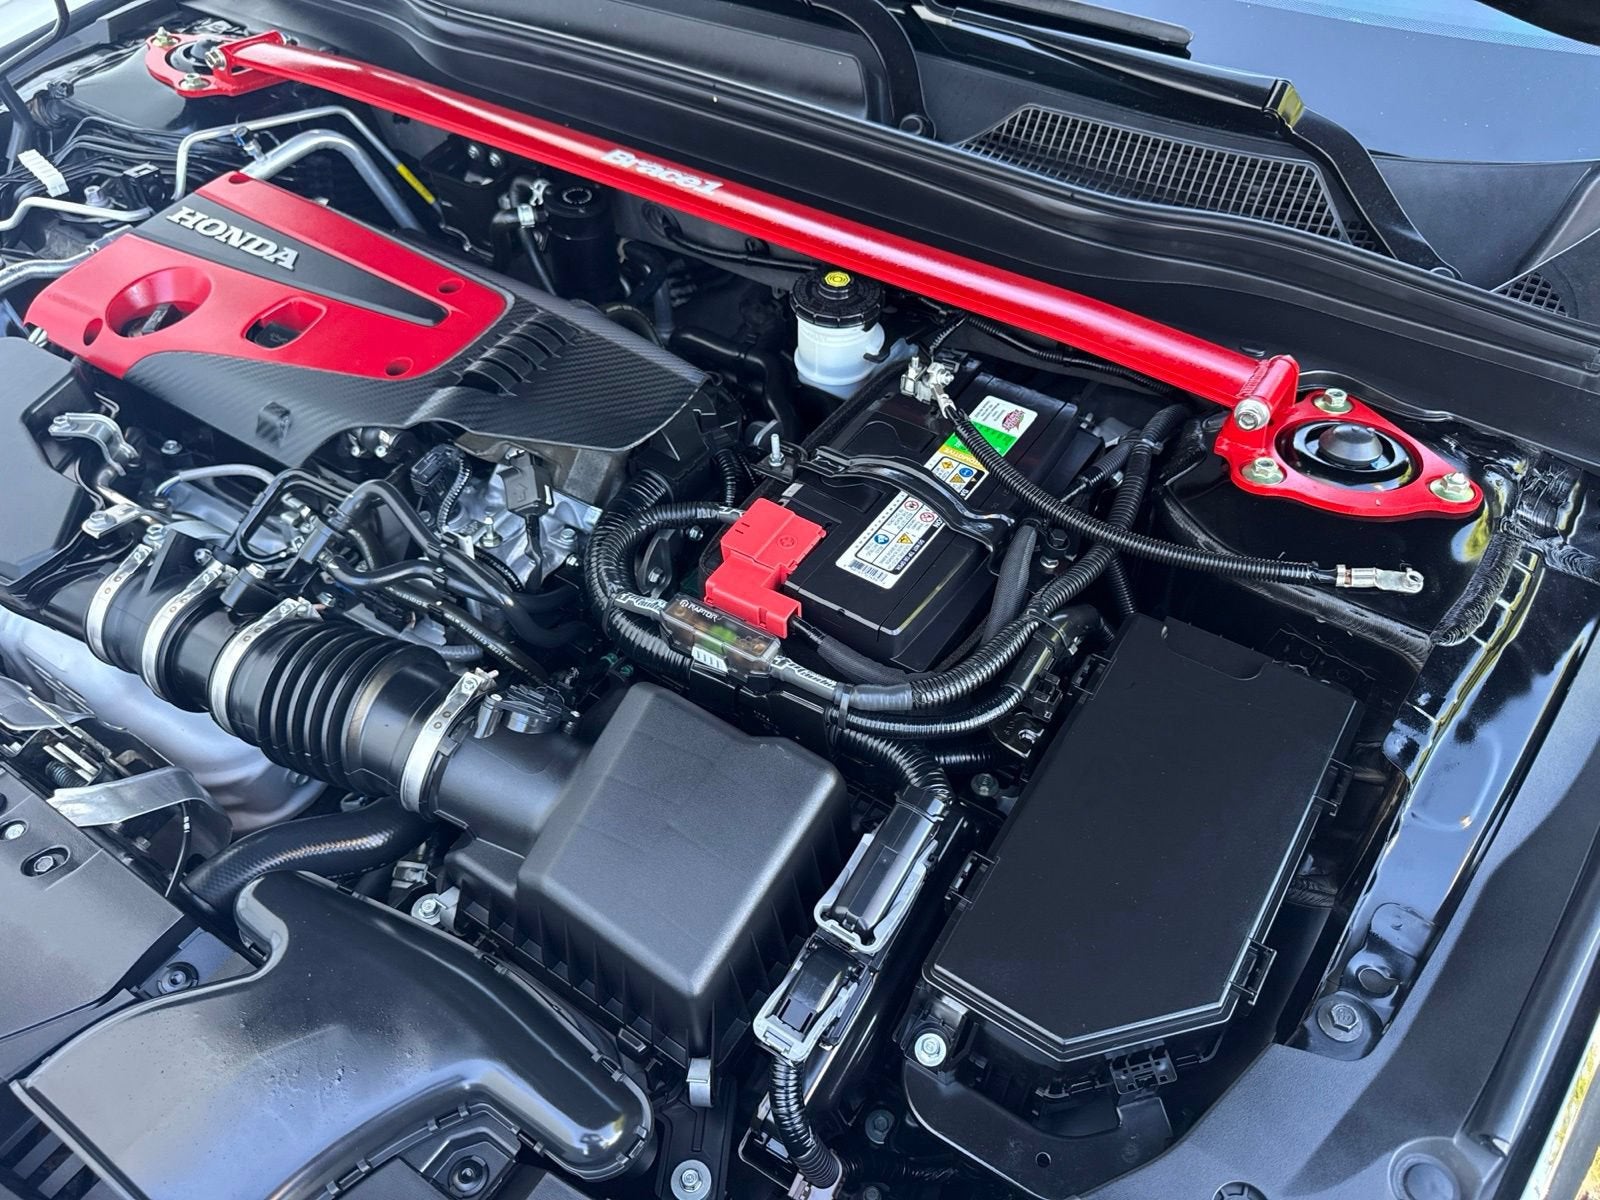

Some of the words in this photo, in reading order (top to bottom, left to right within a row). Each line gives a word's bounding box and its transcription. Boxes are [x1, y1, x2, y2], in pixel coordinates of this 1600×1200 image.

[603, 149, 724, 196] Brace1
[166, 206, 299, 271] HONDA
[942, 446, 980, 468] TOMOTIVE
[688, 602, 718, 623] RAPTOR
